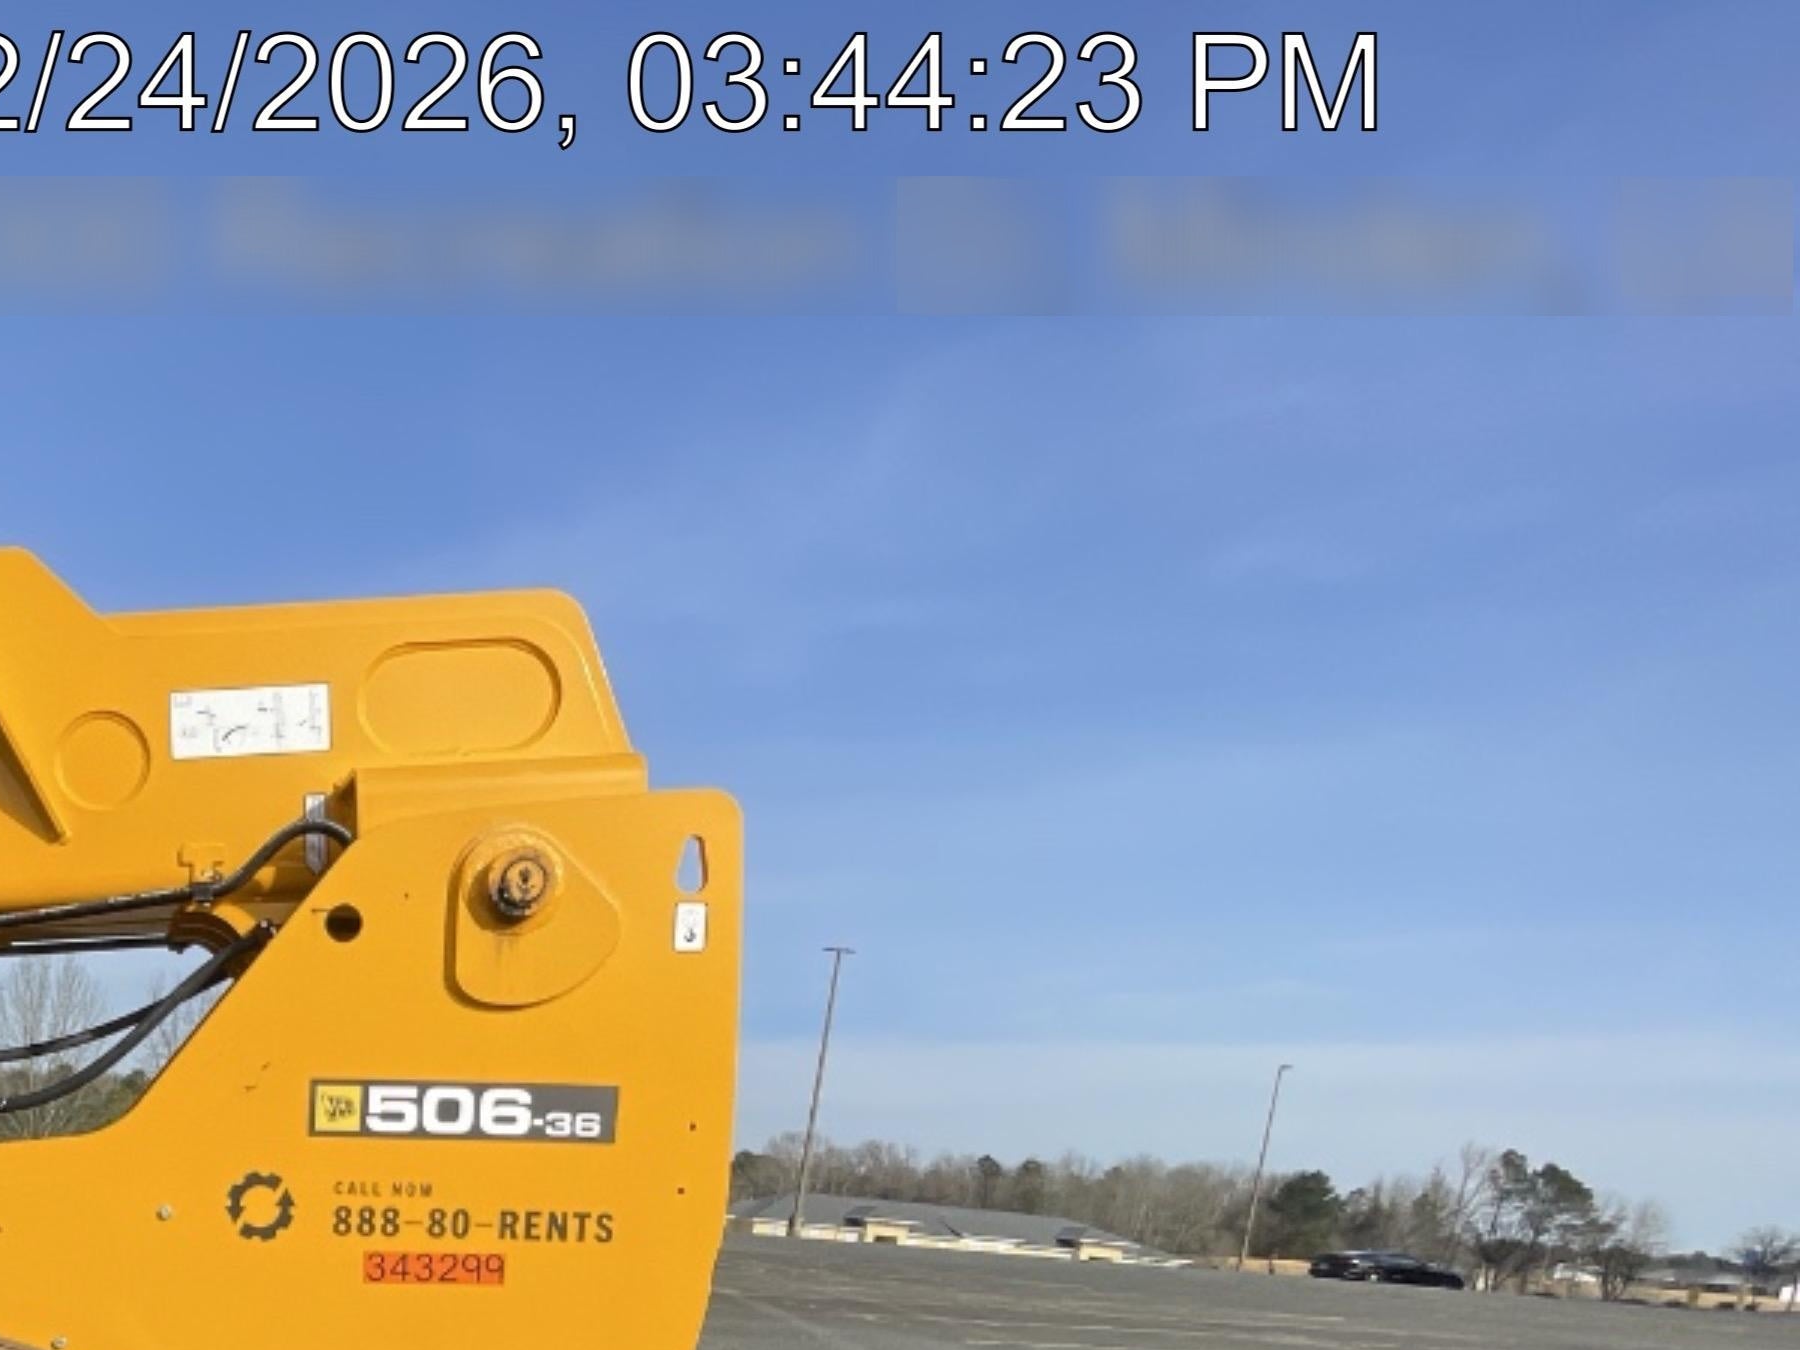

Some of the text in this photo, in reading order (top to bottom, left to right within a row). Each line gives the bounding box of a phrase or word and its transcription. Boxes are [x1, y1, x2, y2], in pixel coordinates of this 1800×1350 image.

[365, 1085, 602, 1138] 506-36
[332, 1181, 433, 1197] CALL NOW
[332, 1205, 614, 1243] 888-80-RENTS
[366, 1252, 505, 1283] 343299
